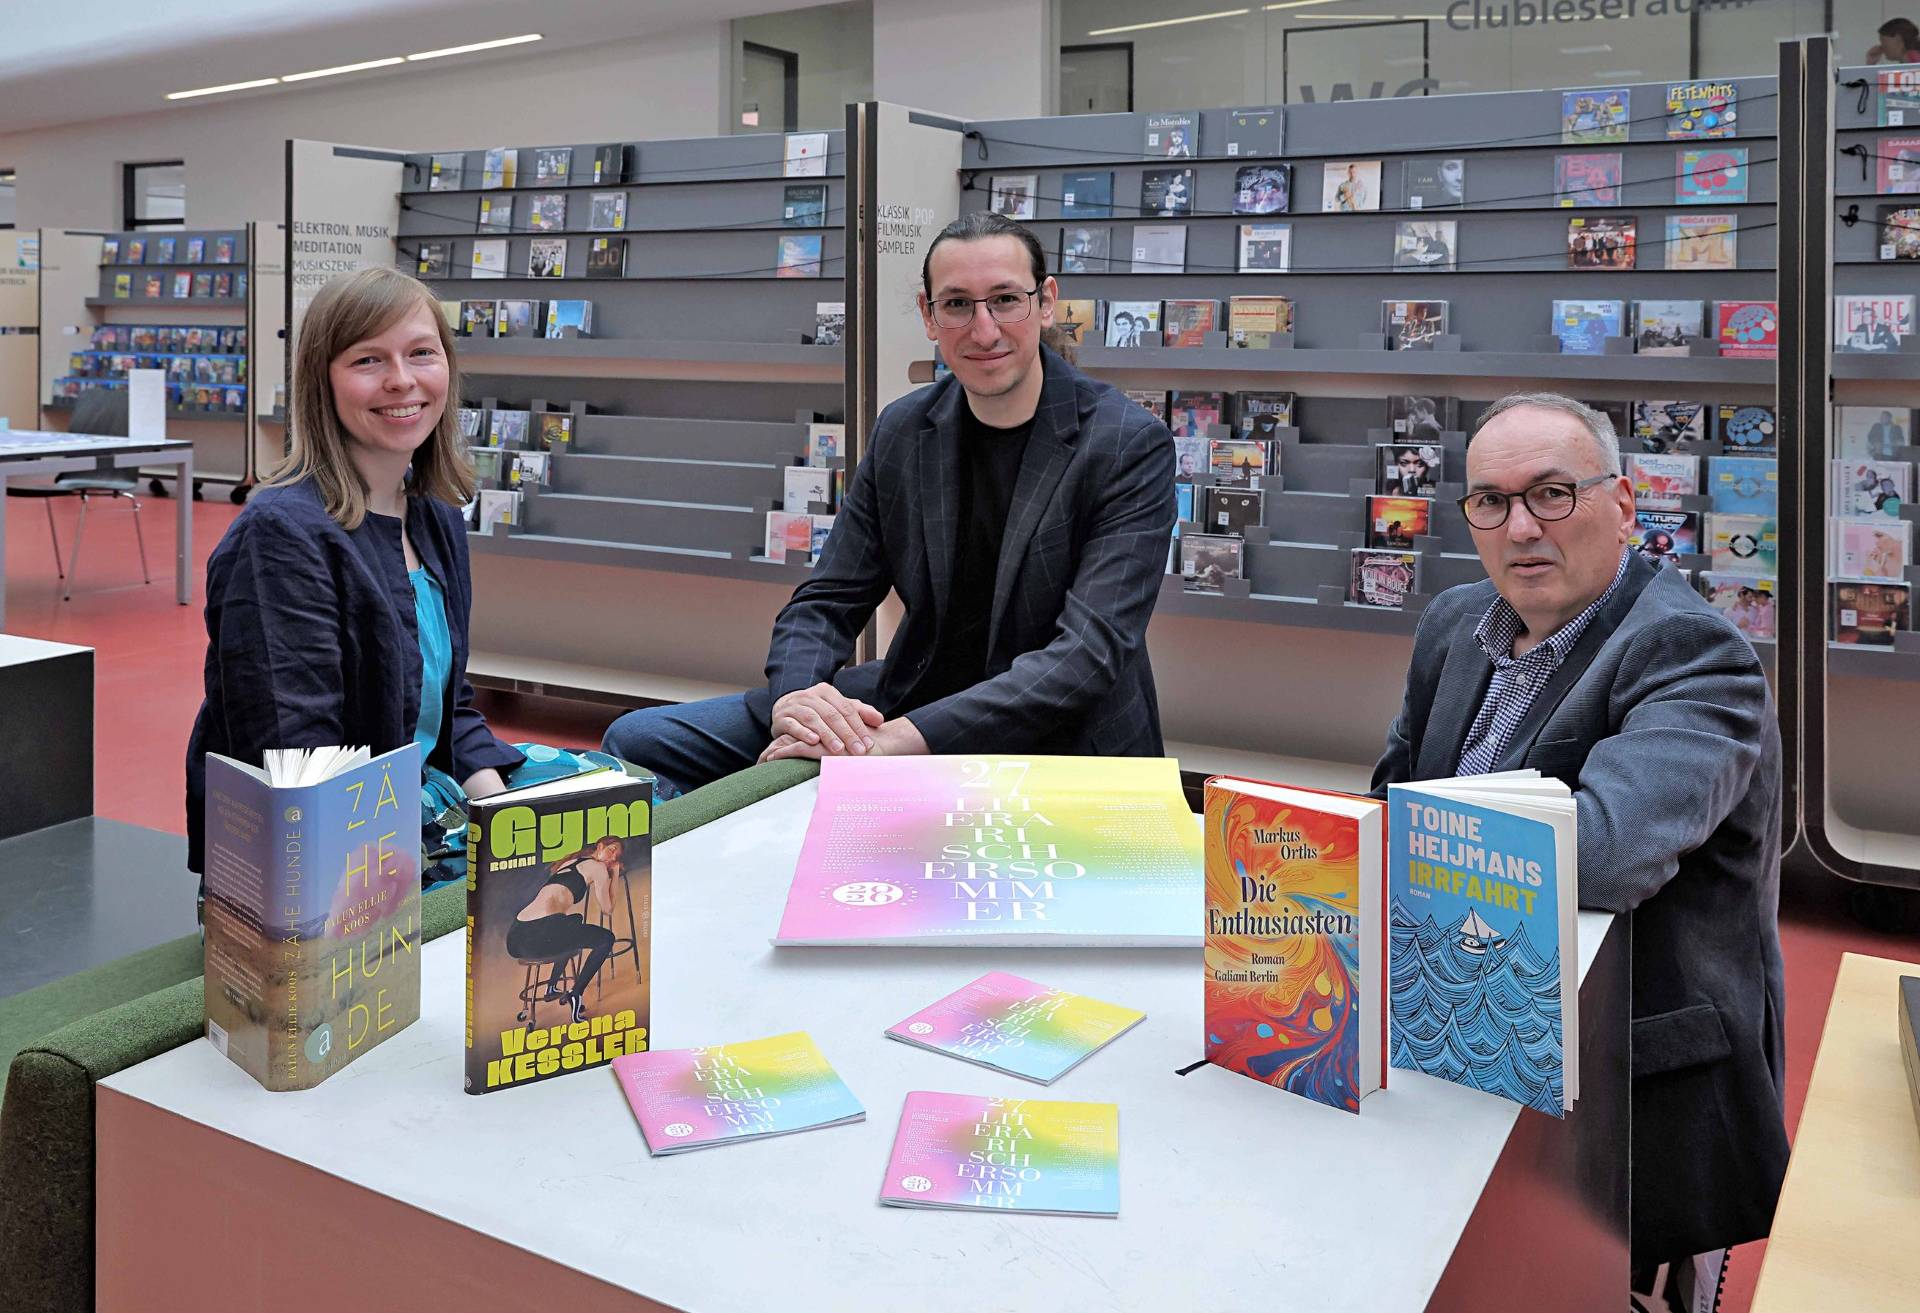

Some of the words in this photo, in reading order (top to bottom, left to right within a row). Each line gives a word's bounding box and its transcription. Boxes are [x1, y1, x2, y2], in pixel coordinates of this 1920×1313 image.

[1887, 71, 1920, 93] LO
[1671, 84, 1733, 100] FETENHITS
[878, 204, 909, 219] KLASSIK
[915, 208, 935, 225] POP
[294, 221, 353, 236] ELEKTRON.
[356, 225, 390, 238] MUSIK
[878, 223, 922, 237] FILMMUSIK
[293, 240, 362, 254] MEDITATION
[878, 241, 915, 254] SAMPLER
[960, 760, 1031, 798] 27
[346, 763, 398, 831] ZÄ
[943, 812, 1055, 827] ERA
[1407, 802, 1482, 843] TOINE
[490, 799, 650, 863] Gym
[972, 827, 1030, 843] RI
[1254, 828, 1301, 846] Markus
[286, 826, 301, 896] HUNDE
[941, 843, 1063, 860] SCH
[1280, 844, 1318, 862] Orths
[1409, 831, 1543, 887] HEIJMANS
[346, 831, 397, 897] HE
[490, 856, 537, 872] ROMAN
[919, 861, 1086, 880] ERSO
[951, 881, 1060, 899] MM
[1241, 875, 1277, 903] Die
[1409, 859, 1538, 915] IRRFAHRT
[1409, 888, 1431, 900] ROMAN
[358, 890, 388, 914] ELLIE
[962, 901, 1052, 921] ER
[344, 914, 370, 935] KOOS
[1209, 909, 1352, 935] Enthusiasten
[283, 904, 301, 961] ZÄHE
[332, 915, 413, 999] HUN
[1251, 953, 1285, 966] Roman
[1215, 969, 1248, 983] Galiani
[1250, 970, 1279, 983] Berlin
[288, 971, 297, 1001] KOOS
[348, 988, 396, 1051] DE
[1007, 1002, 1055, 1022] ERA
[288, 1005, 297, 1040] ELLIE
[980, 1017, 1031, 1037] SCH
[500, 1009, 636, 1057] Verena
[960, 1023, 1026, 1048] ERSO
[959, 1035, 1001, 1054] MM
[287, 1043, 297, 1080] FALUN
[487, 1027, 649, 1088] KESSLER
[692, 1056, 740, 1071] LIT
[693, 1067, 752, 1082] ERA
[714, 1078, 746, 1092] RI
[706, 1086, 765, 1105] SCH
[704, 1097, 781, 1117] ERSO
[725, 1111, 775, 1128] MM
[980, 1111, 1033, 1125] LIT
[974, 1124, 1033, 1139] ERA
[986, 1138, 1018, 1152] RI
[968, 1150, 1031, 1167] SCH
[957, 1164, 1041, 1182] ERSO
[970, 1180, 1023, 1196] MM
